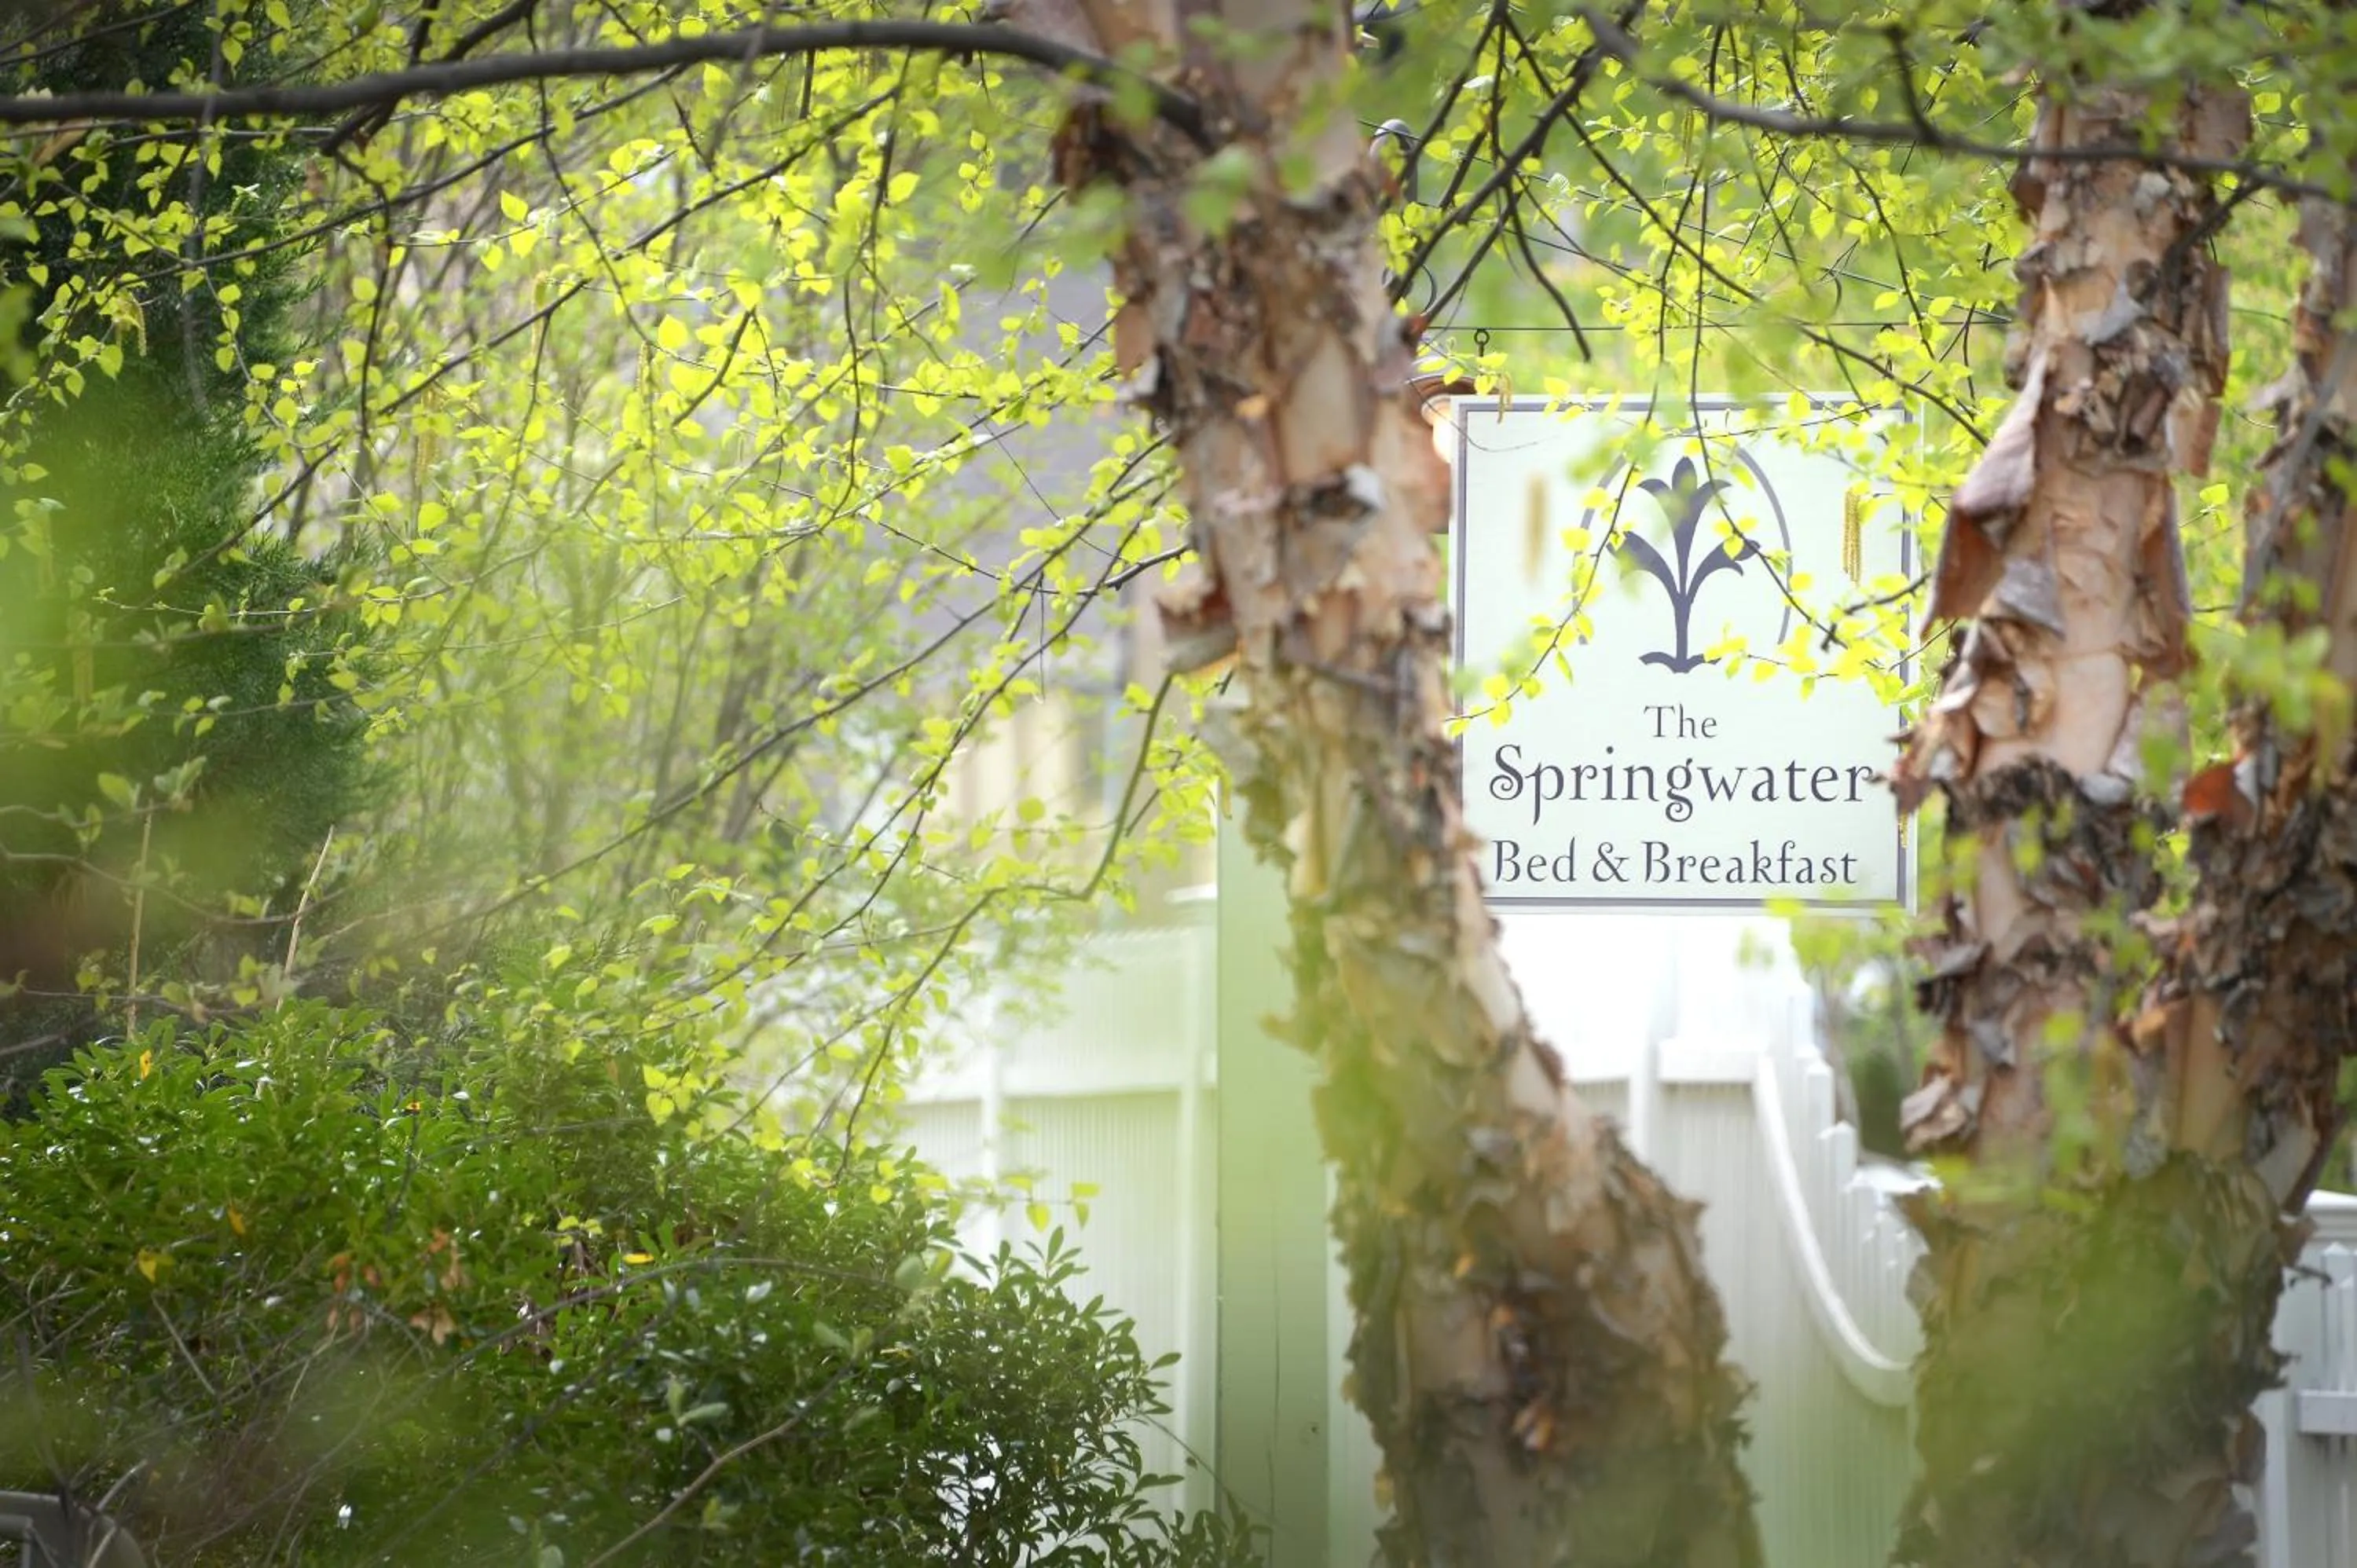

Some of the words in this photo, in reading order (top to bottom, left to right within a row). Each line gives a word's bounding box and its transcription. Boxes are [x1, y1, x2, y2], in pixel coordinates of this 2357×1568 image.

[1644, 703, 1717, 738] The
[1489, 744, 1873, 826] Springwater
[1493, 837, 1576, 882] Bed
[1592, 841, 1630, 882] &
[1642, 840, 1857, 884] Breakfast
